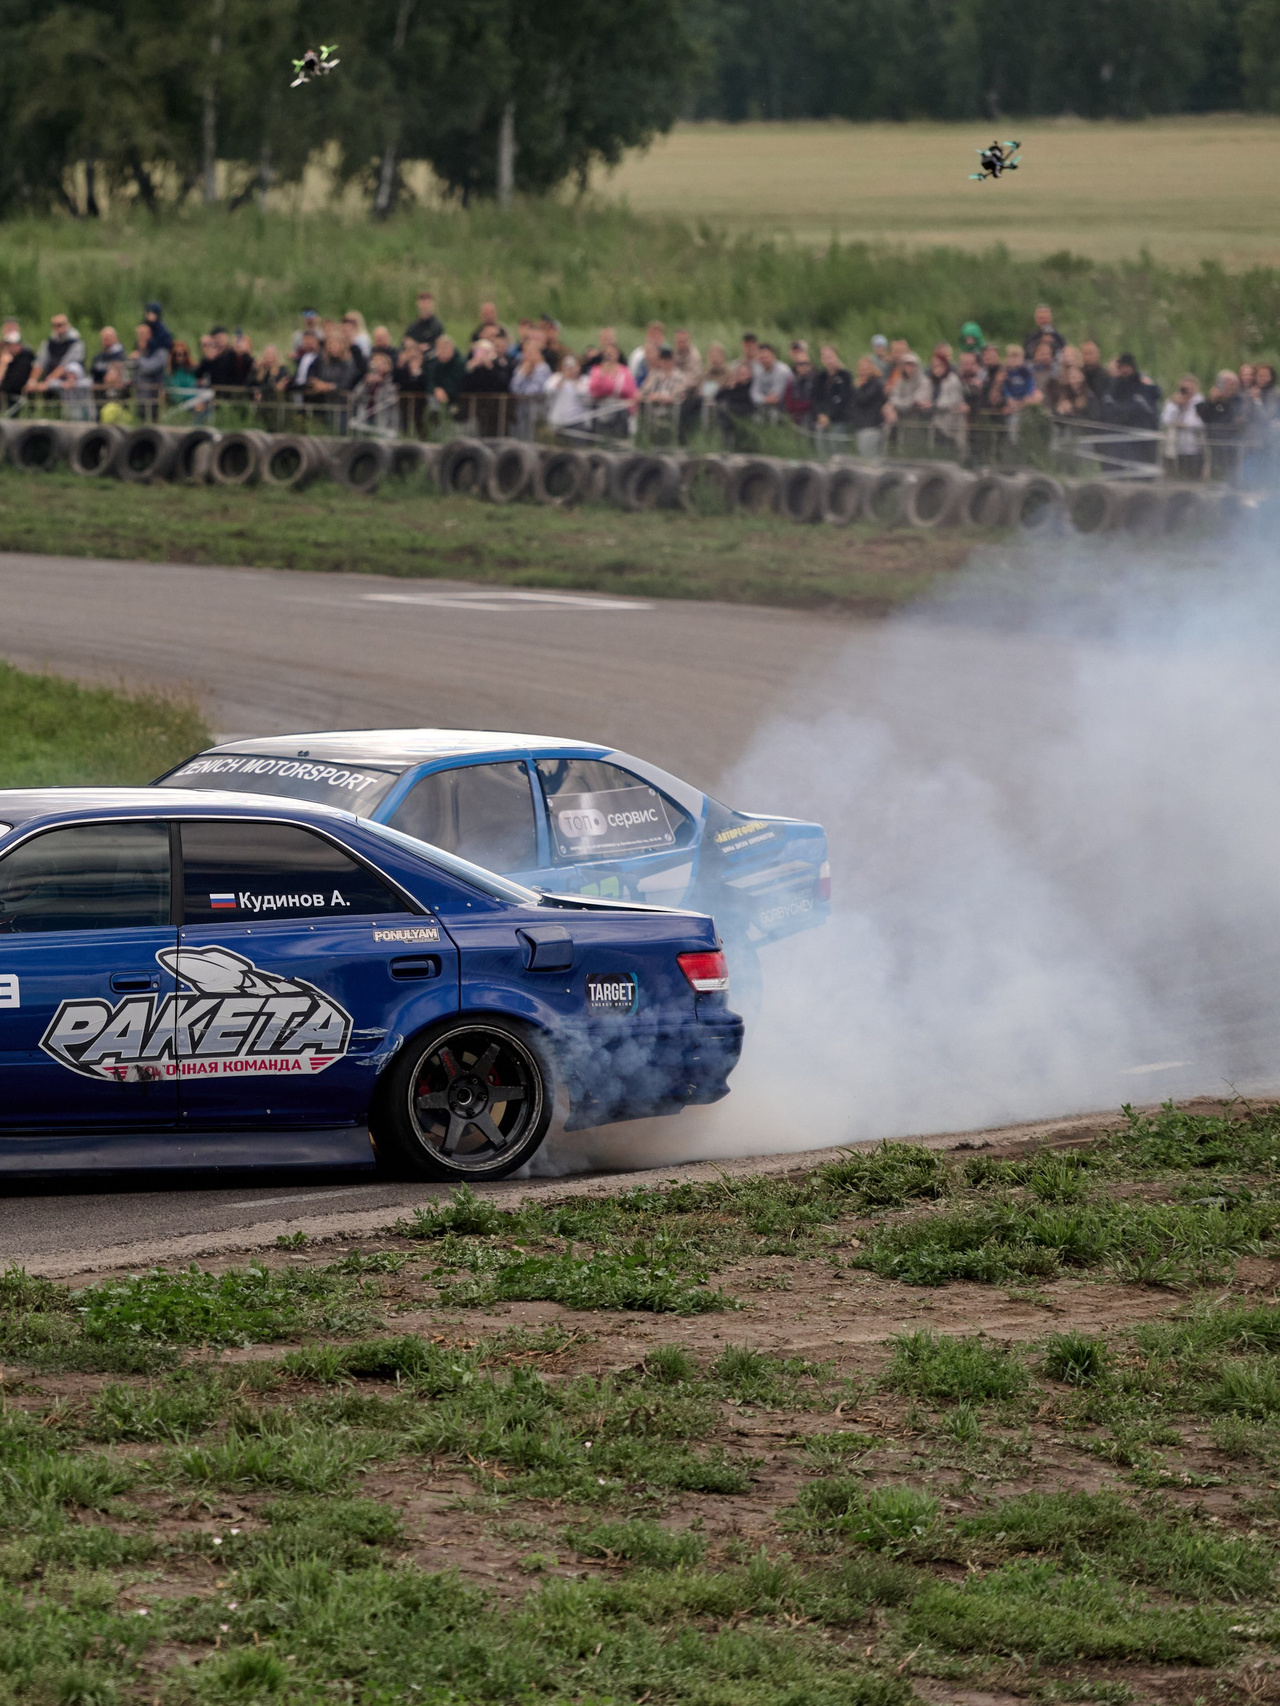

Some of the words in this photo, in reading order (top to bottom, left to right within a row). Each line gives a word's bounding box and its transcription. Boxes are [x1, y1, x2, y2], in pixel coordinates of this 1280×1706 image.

[174, 758, 243, 777] ZENICH
[240, 758, 378, 792] MOTORSPORT
[608, 809, 658, 828] сервис
[238, 892, 325, 912] Кудинов
[331, 890, 351, 906] А.
[374, 928, 438, 942] PONULYAM
[588, 983, 634, 1001] TARGET
[48, 997, 342, 1061] РАКЕТА
[223, 1058, 302, 1074] КОМАНДА
